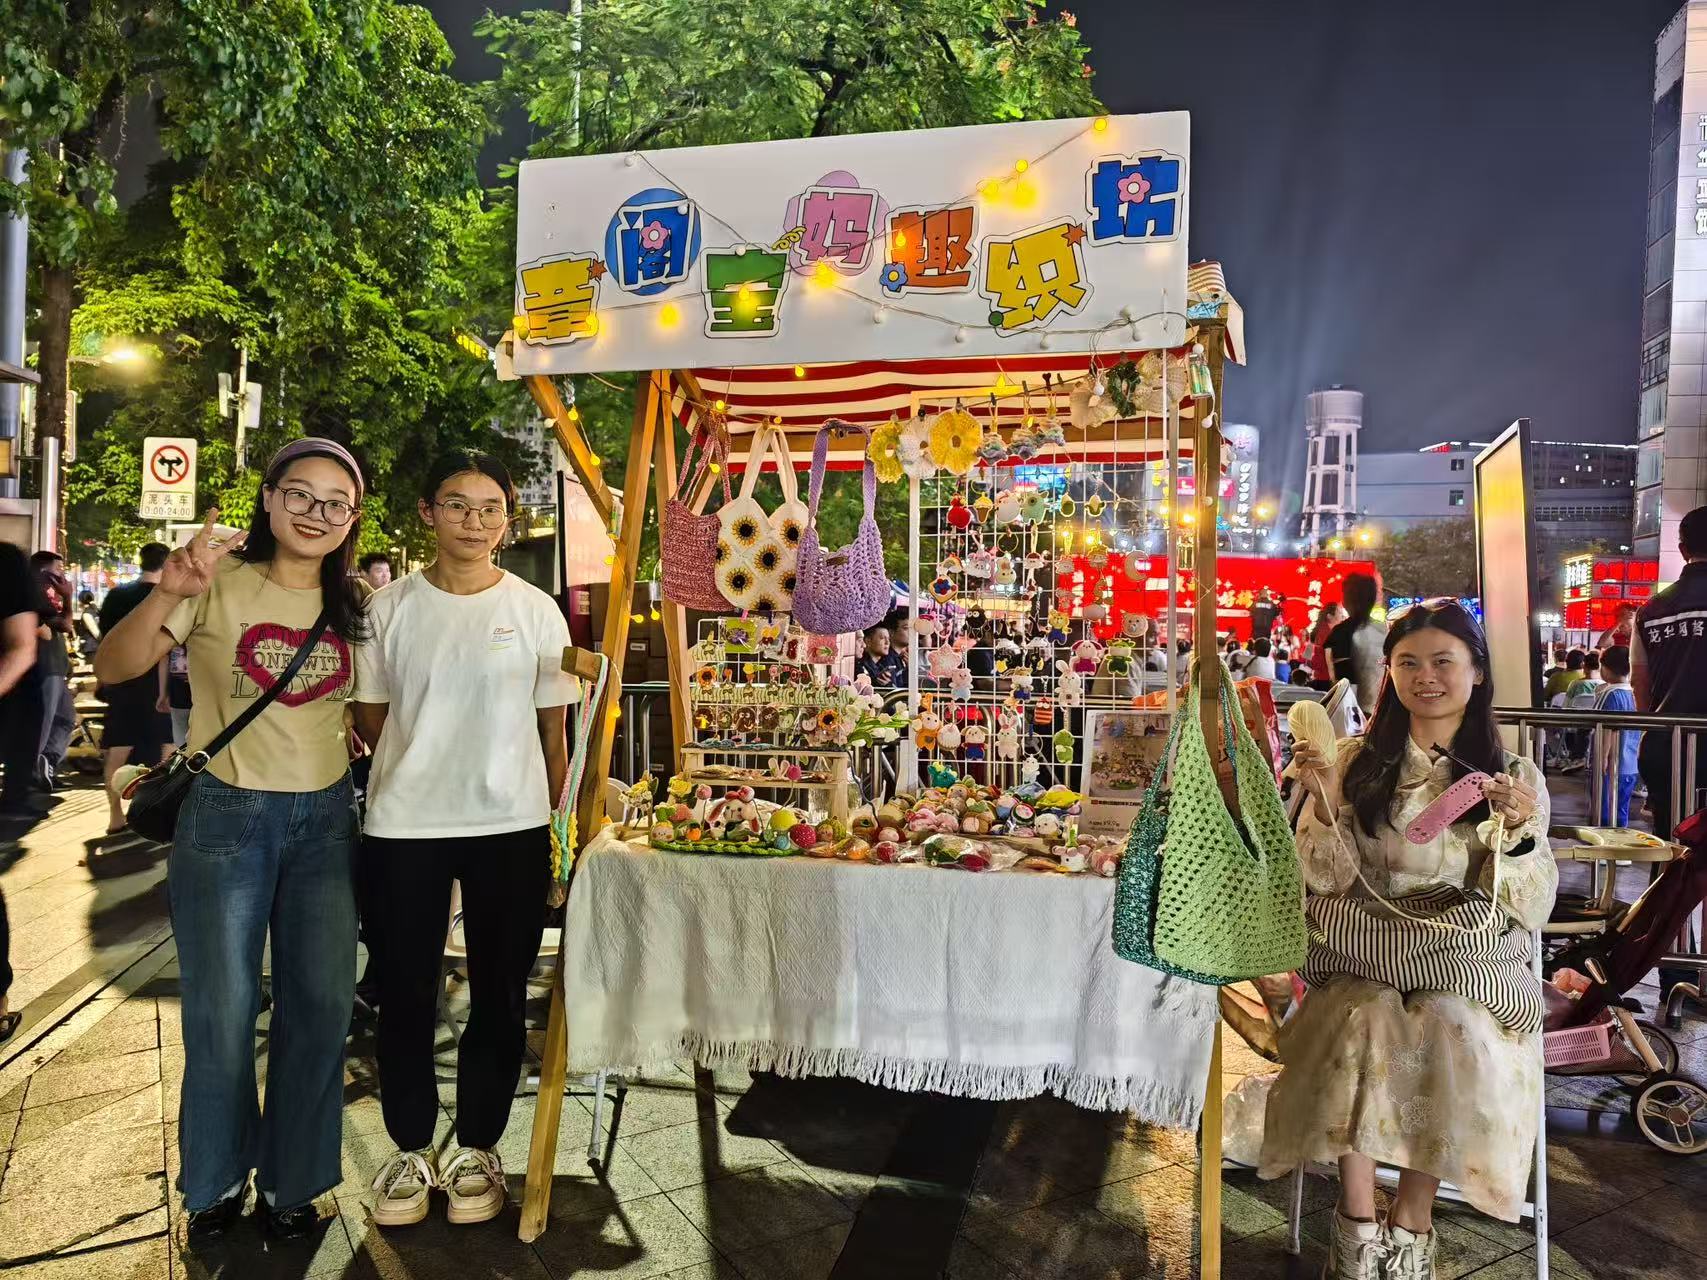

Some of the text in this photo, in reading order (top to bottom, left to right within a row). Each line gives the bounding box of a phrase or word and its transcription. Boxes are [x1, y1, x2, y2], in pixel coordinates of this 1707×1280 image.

[522, 155, 1181, 341] 章阁宝妈趣织坊
[149, 493, 190, 506] 泥头车
[232, 651, 294, 670] DONE
[231, 670, 351, 702] LOVE
